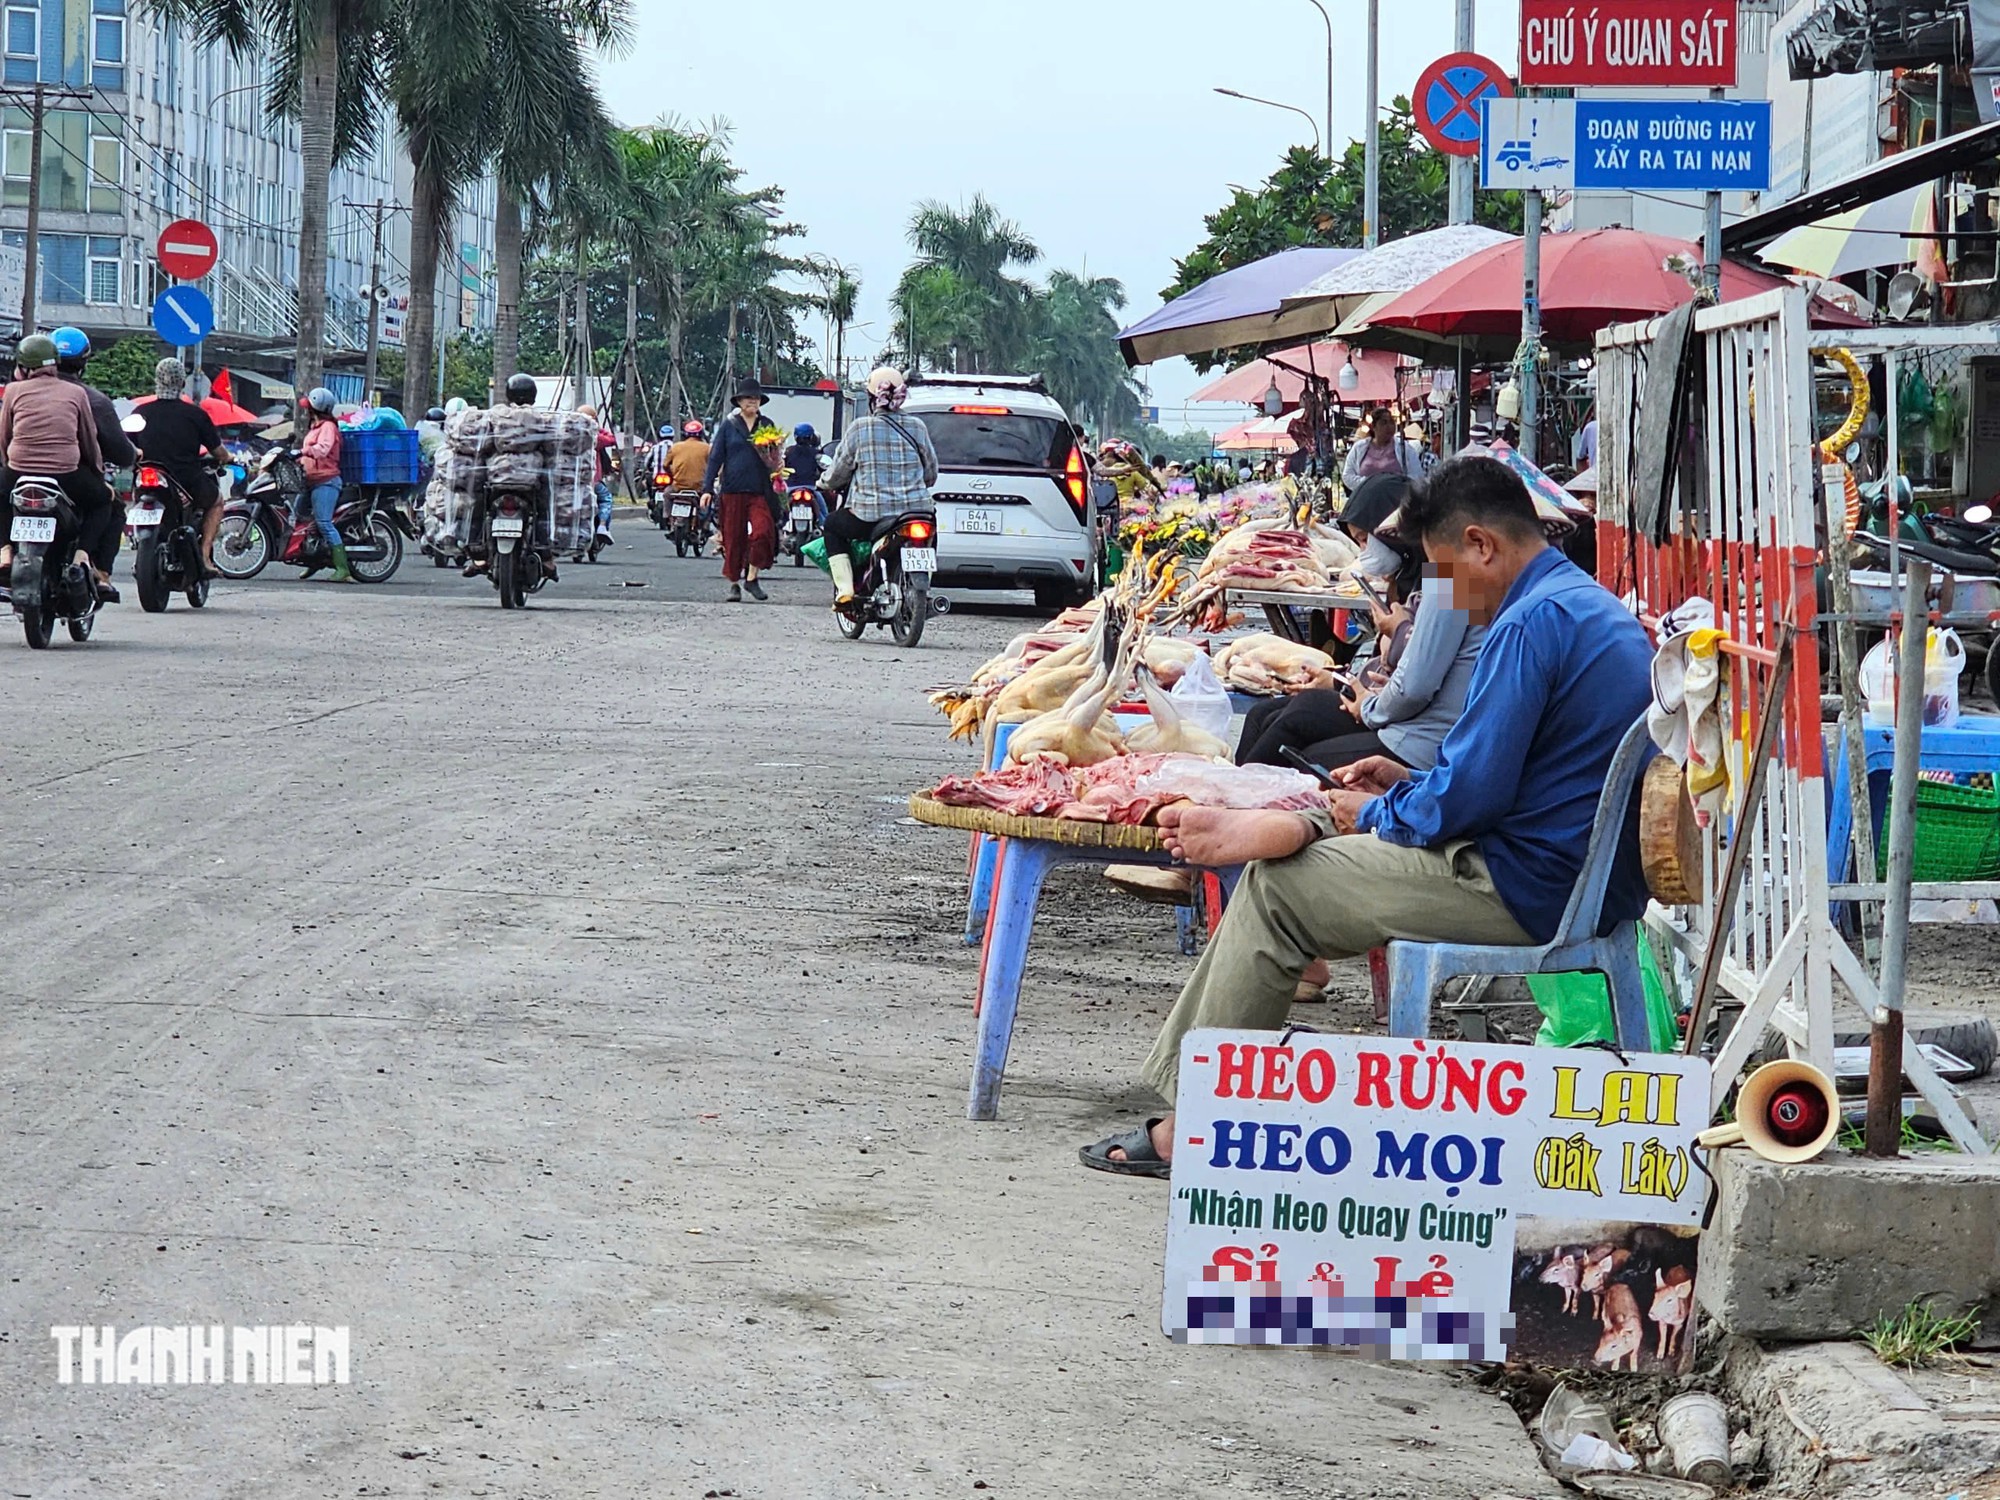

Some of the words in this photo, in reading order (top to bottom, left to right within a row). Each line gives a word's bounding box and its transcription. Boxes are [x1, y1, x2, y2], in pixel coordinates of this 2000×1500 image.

[1527, 7, 1575, 66] CHÚ
[1583, 7, 1599, 66] Ý
[1605, 18, 1672, 66] QUAN
[1680, 9, 1729, 67] SÁT
[1587, 119, 1639, 143] ĐOẠN
[1648, 114, 1712, 140] ĐƯỜNG
[1720, 120, 1756, 141] HAY
[1594, 144, 1630, 169] XẢY
[1639, 150, 1665, 170] RA
[1673, 150, 1701, 170] TAI
[1711, 151, 1751, 175] NẠN
[961, 521, 996, 531] 160.16
[968, 510, 988, 520] 64A
[1353, 1039, 1527, 1116] RỪNG
[1549, 1066, 1683, 1127] LAI
[1372, 1130, 1506, 1197] MỌI
[1534, 1132, 1603, 1197] (Đắk
[1619, 1137, 1689, 1202] Lắk)
[1178, 1187, 1263, 1235] “Nhận
[1272, 1193, 1328, 1233] Heo
[1338, 1197, 1410, 1242] Quay
[1419, 1202, 1507, 1249] Cúng”
